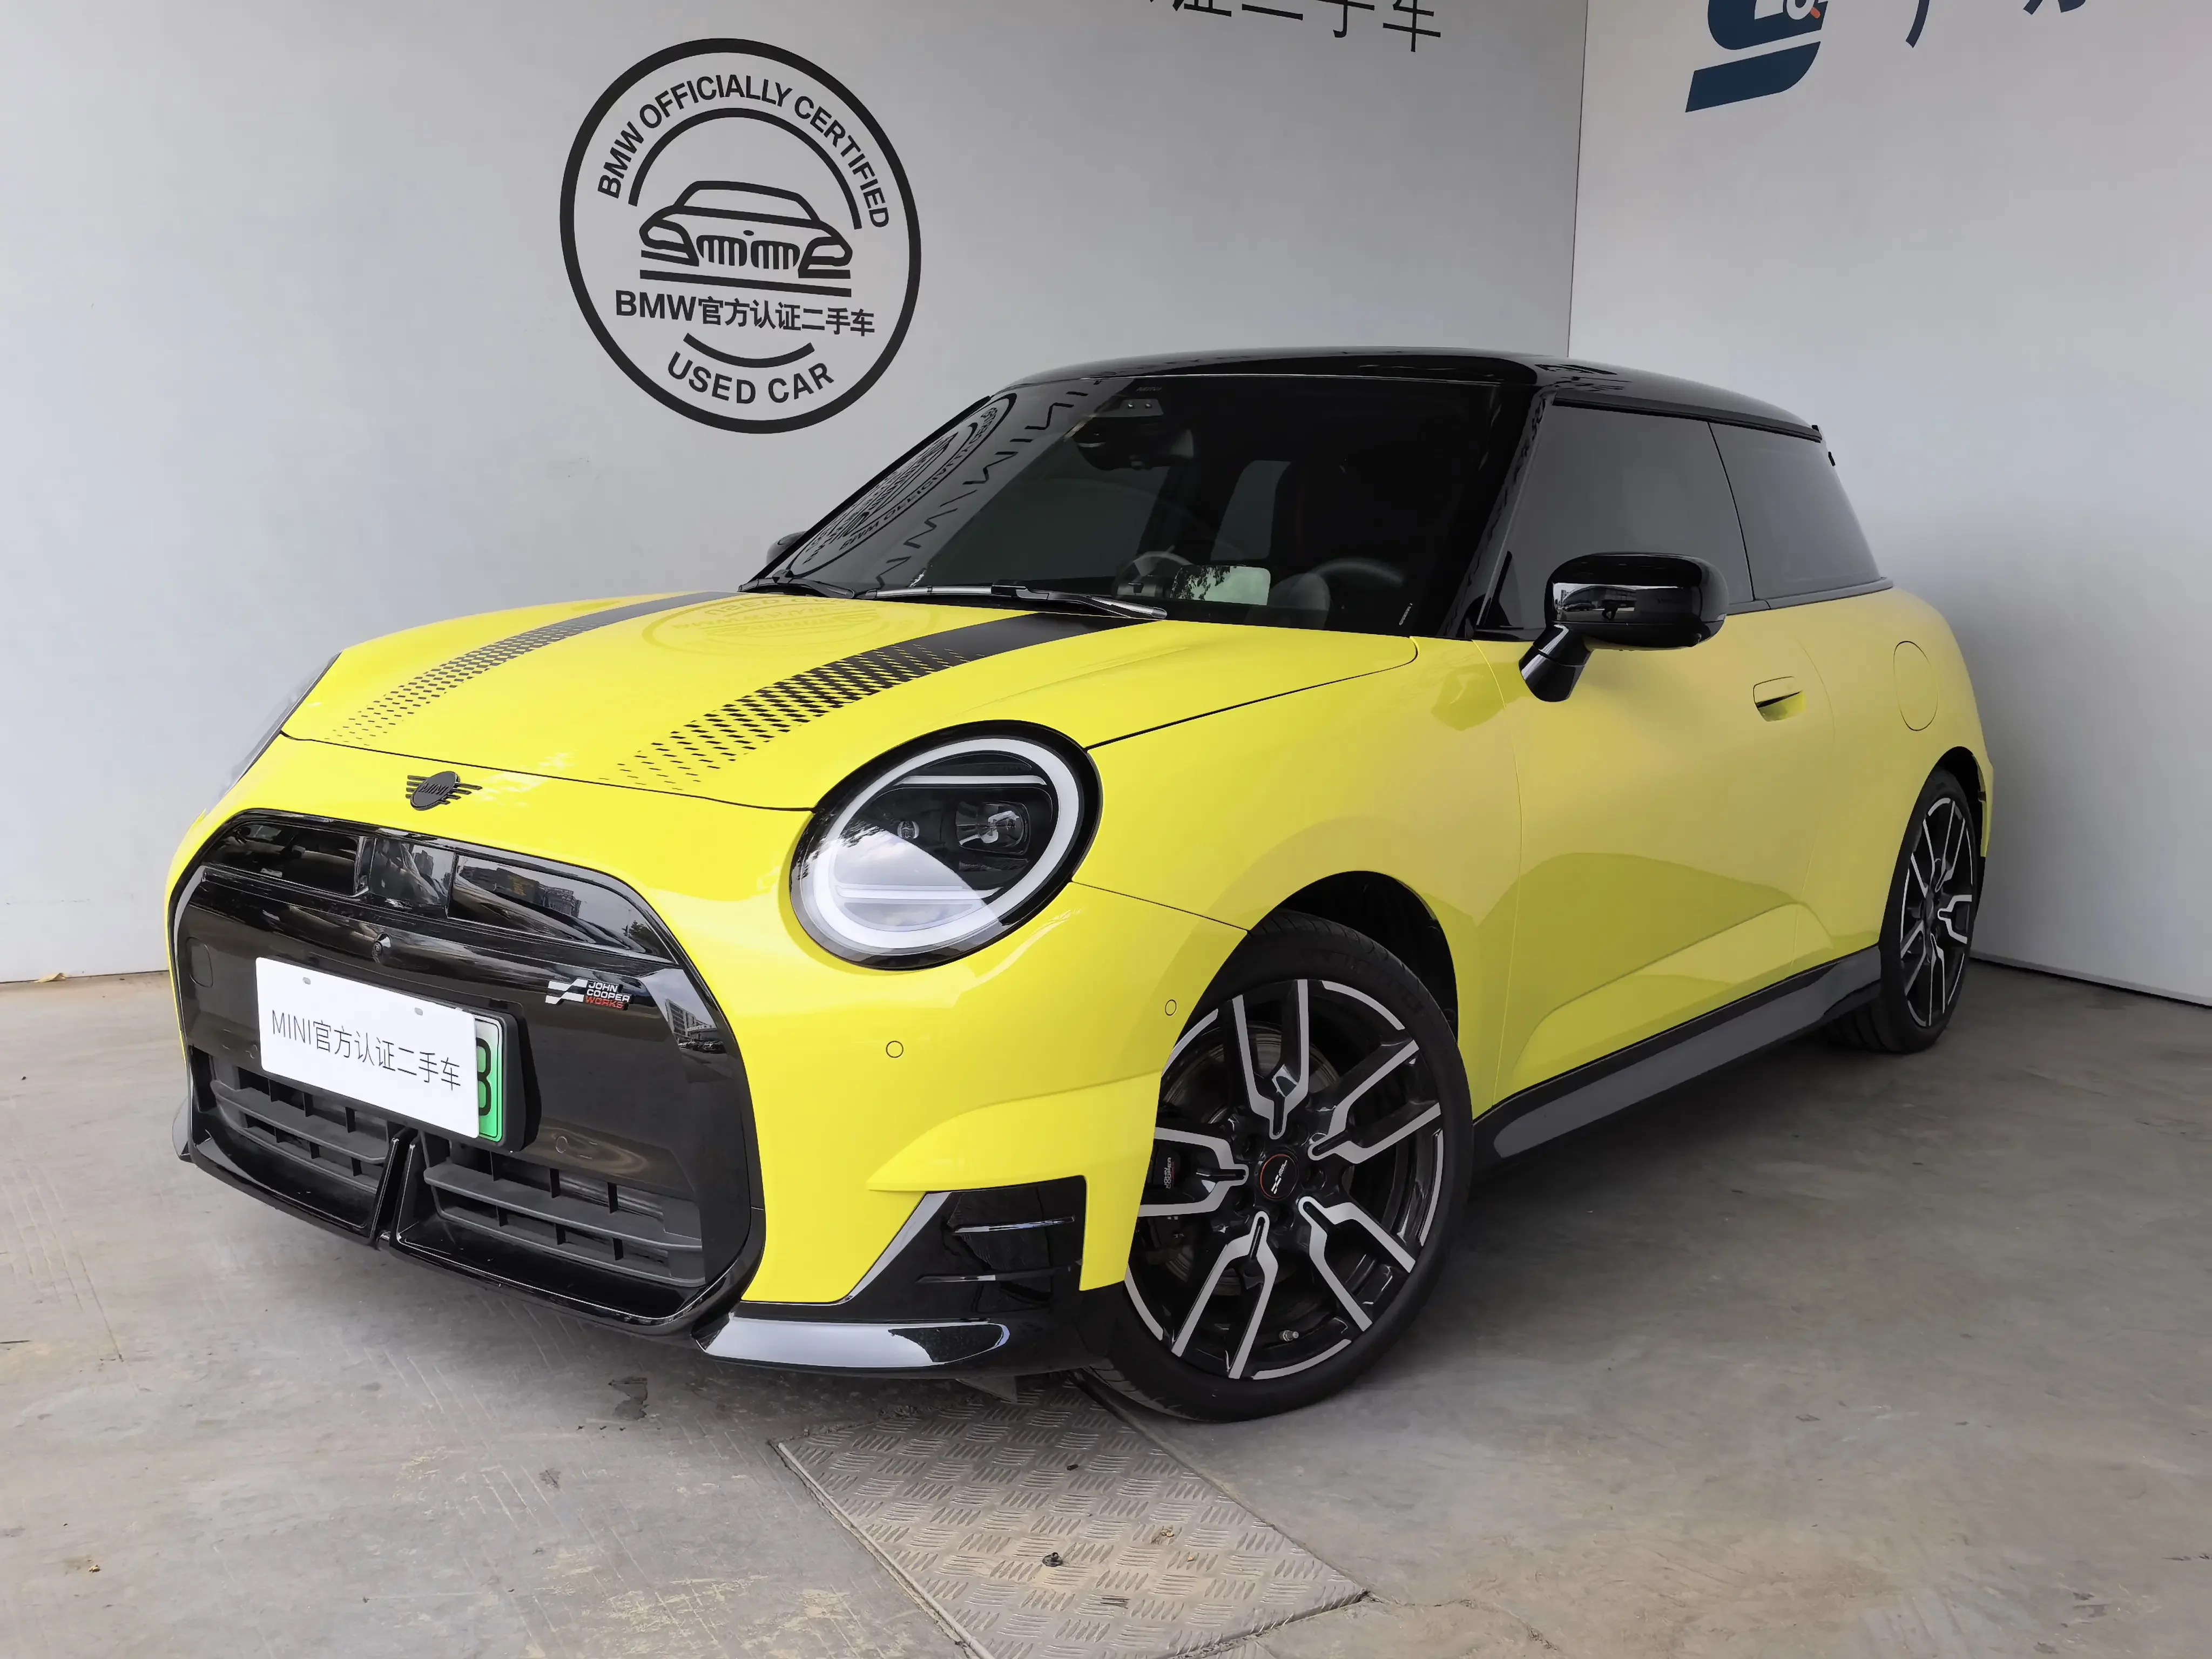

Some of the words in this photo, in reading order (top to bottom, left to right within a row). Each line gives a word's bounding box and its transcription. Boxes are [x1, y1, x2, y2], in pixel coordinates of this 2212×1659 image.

[597, 121, 645, 198] BMW
[639, 74, 793, 129] OFFICIALLY
[794, 96, 889, 228] CERTIFIED
[615, 289, 875, 336] BMW官方认证二手车
[668, 351, 756, 404] USED
[767, 362, 835, 404] CAR
[418, 783, 449, 795] MINI
[587, 989, 630, 1002] COOPER
[589, 982, 618, 992] JOHN
[587, 996, 623, 1009] WORKS
[272, 1009, 461, 1091] MINI官方认证二手车
